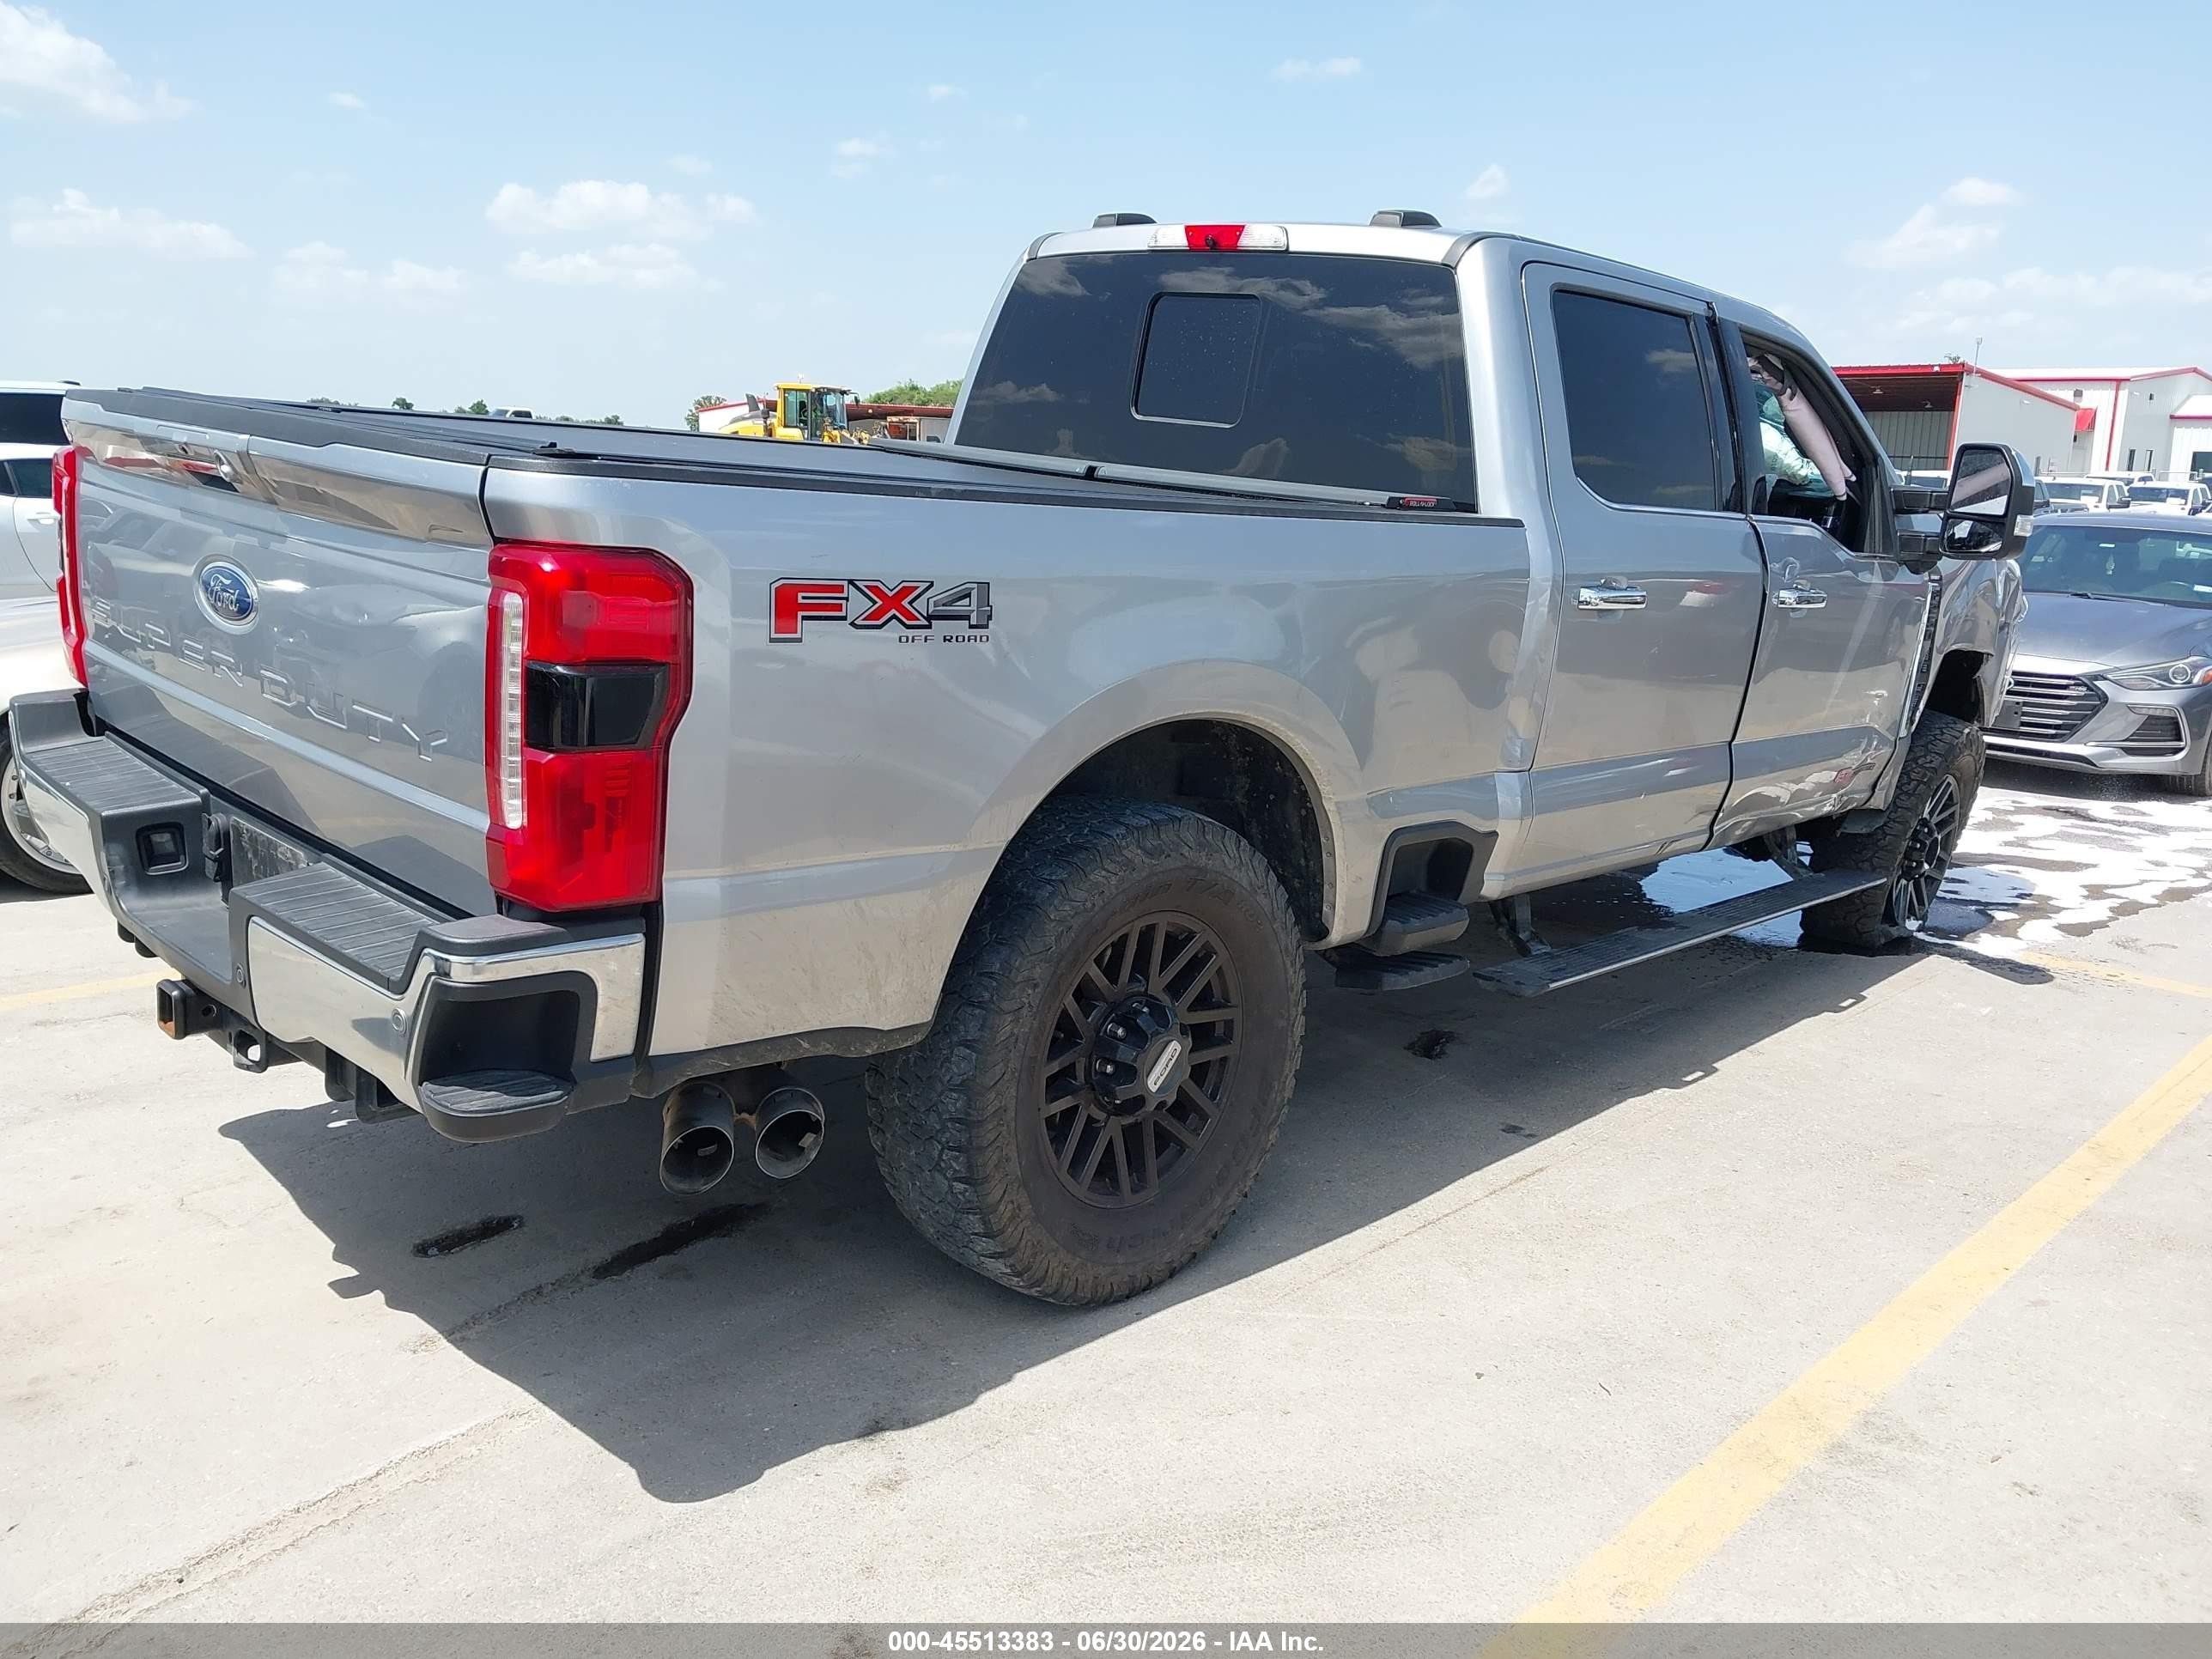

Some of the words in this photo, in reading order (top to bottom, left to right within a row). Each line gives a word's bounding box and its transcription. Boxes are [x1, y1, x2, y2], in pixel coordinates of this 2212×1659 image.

[208, 573, 240, 612] Ford
[769, 576, 994, 643] FX4
[898, 635, 935, 644] OFF
[943, 635, 989, 644] ROAD
[87, 594, 244, 687] SUPER
[259, 664, 448, 763] DUTY
[1153, 1048, 1177, 1086] FORD
